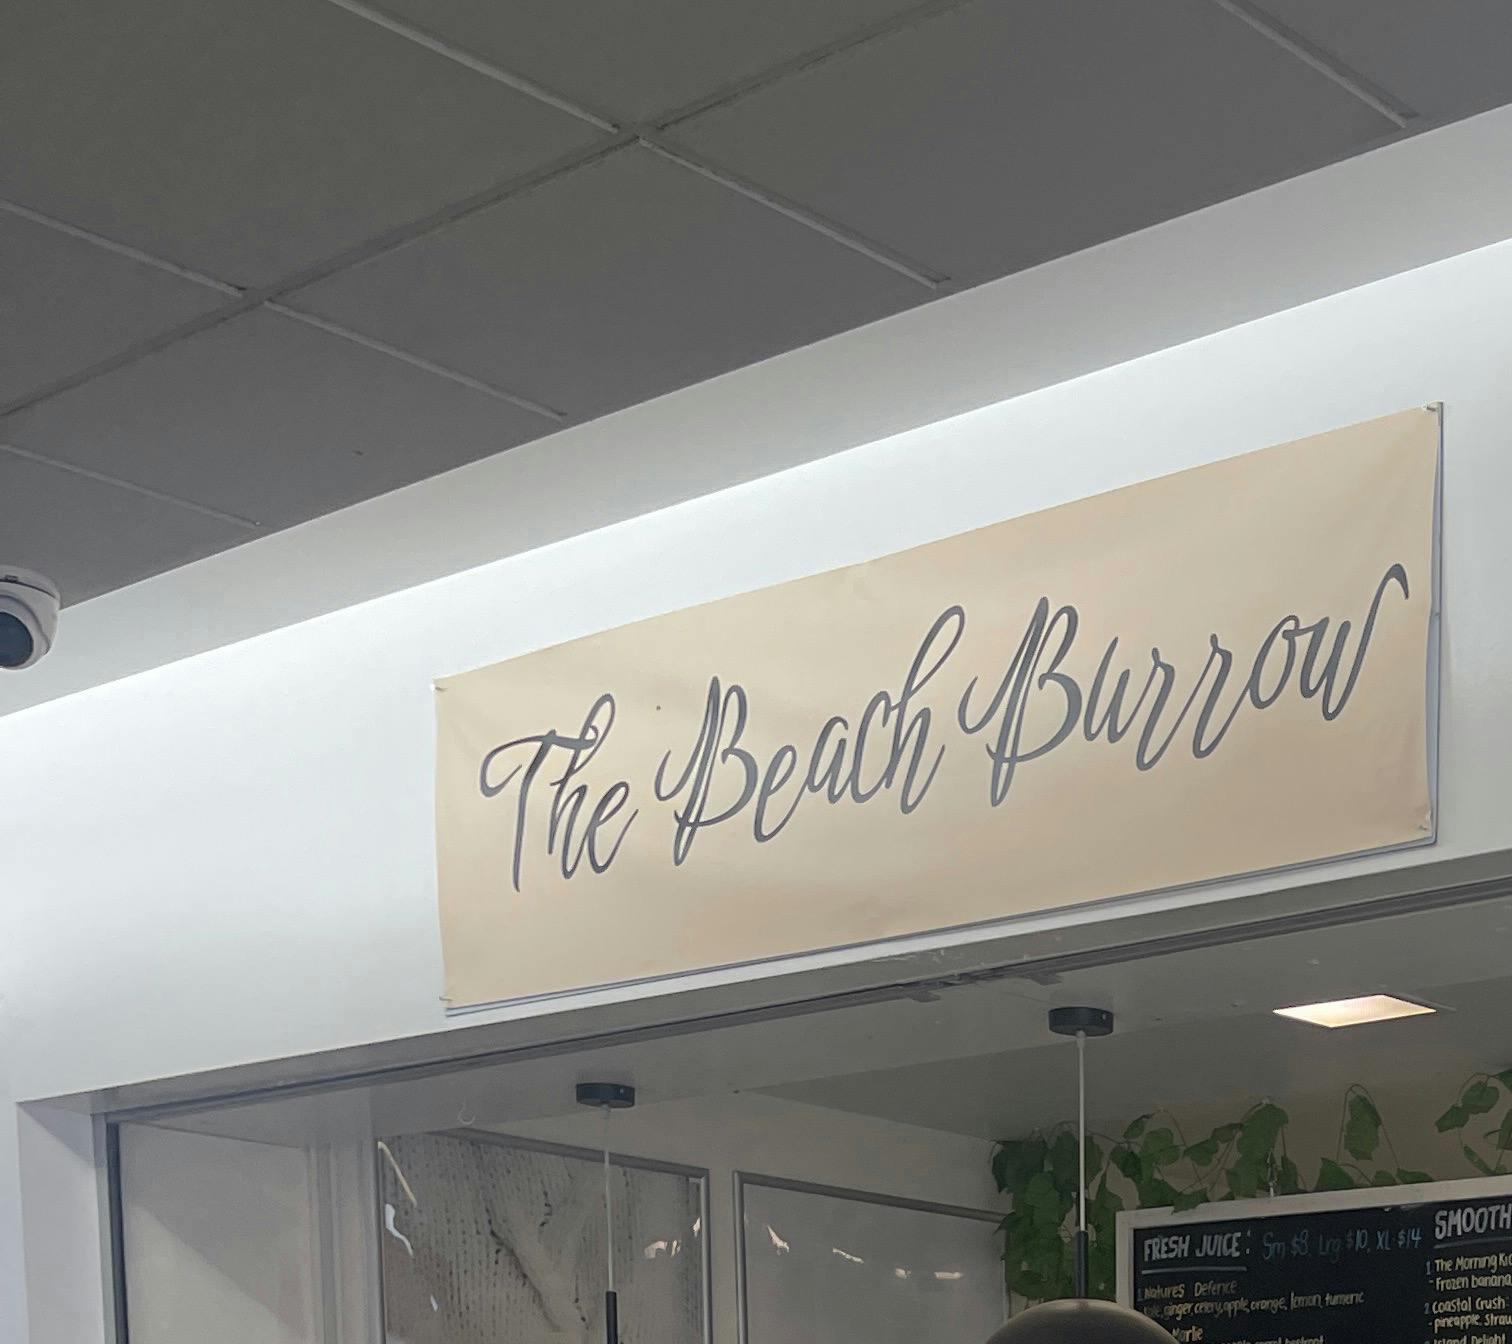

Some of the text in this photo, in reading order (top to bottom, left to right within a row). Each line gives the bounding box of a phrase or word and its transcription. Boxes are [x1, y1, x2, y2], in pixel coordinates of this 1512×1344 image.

[481, 562, 1409, 892] The Beach Burrow
[1143, 1234, 1191, 1262] FRESH
[1375, 1230, 1391, 1251] XL
[1435, 1258, 1453, 1273] The
[1455, 1255, 1498, 1273] Morning
[1436, 1277, 1469, 1293] Frozen
